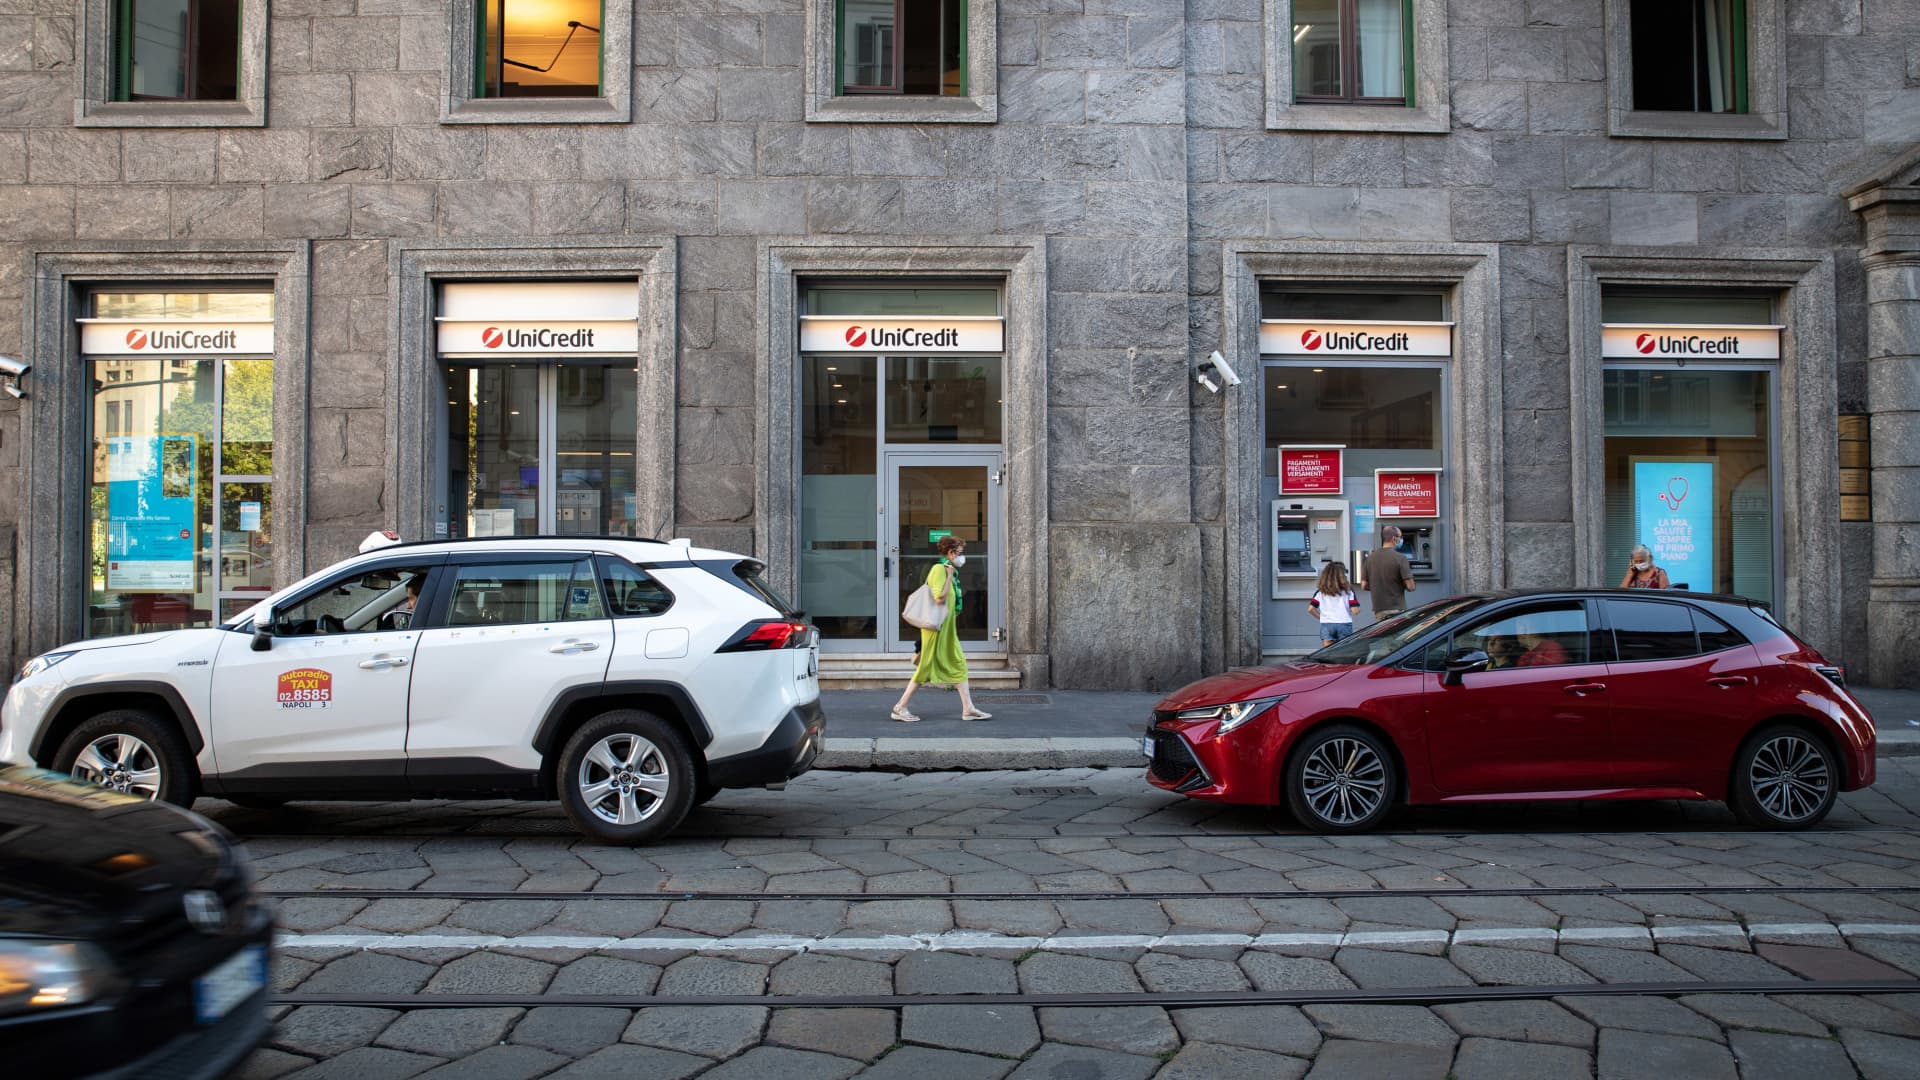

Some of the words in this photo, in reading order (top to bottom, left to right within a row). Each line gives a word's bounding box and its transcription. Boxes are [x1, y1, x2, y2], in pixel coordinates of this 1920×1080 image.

[151, 331, 237, 349] UniCredit
[507, 329, 594, 347] UniCredit
[871, 328, 958, 346] UniCredit
[1326, 331, 1408, 350] UniCredit
[1659, 335, 1739, 354] UniCredit
[1653, 527, 1685, 536] SALUTE
[1657, 536, 1692, 544] SEMPRE
[1654, 543, 1665, 552] IN
[1666, 543, 1695, 552] PRIMO
[1661, 551, 1688, 560] PIANO
[281, 670, 329, 682] autoradio
[291, 679, 319, 689] TAXI
[280, 689, 329, 701] 02.8585
